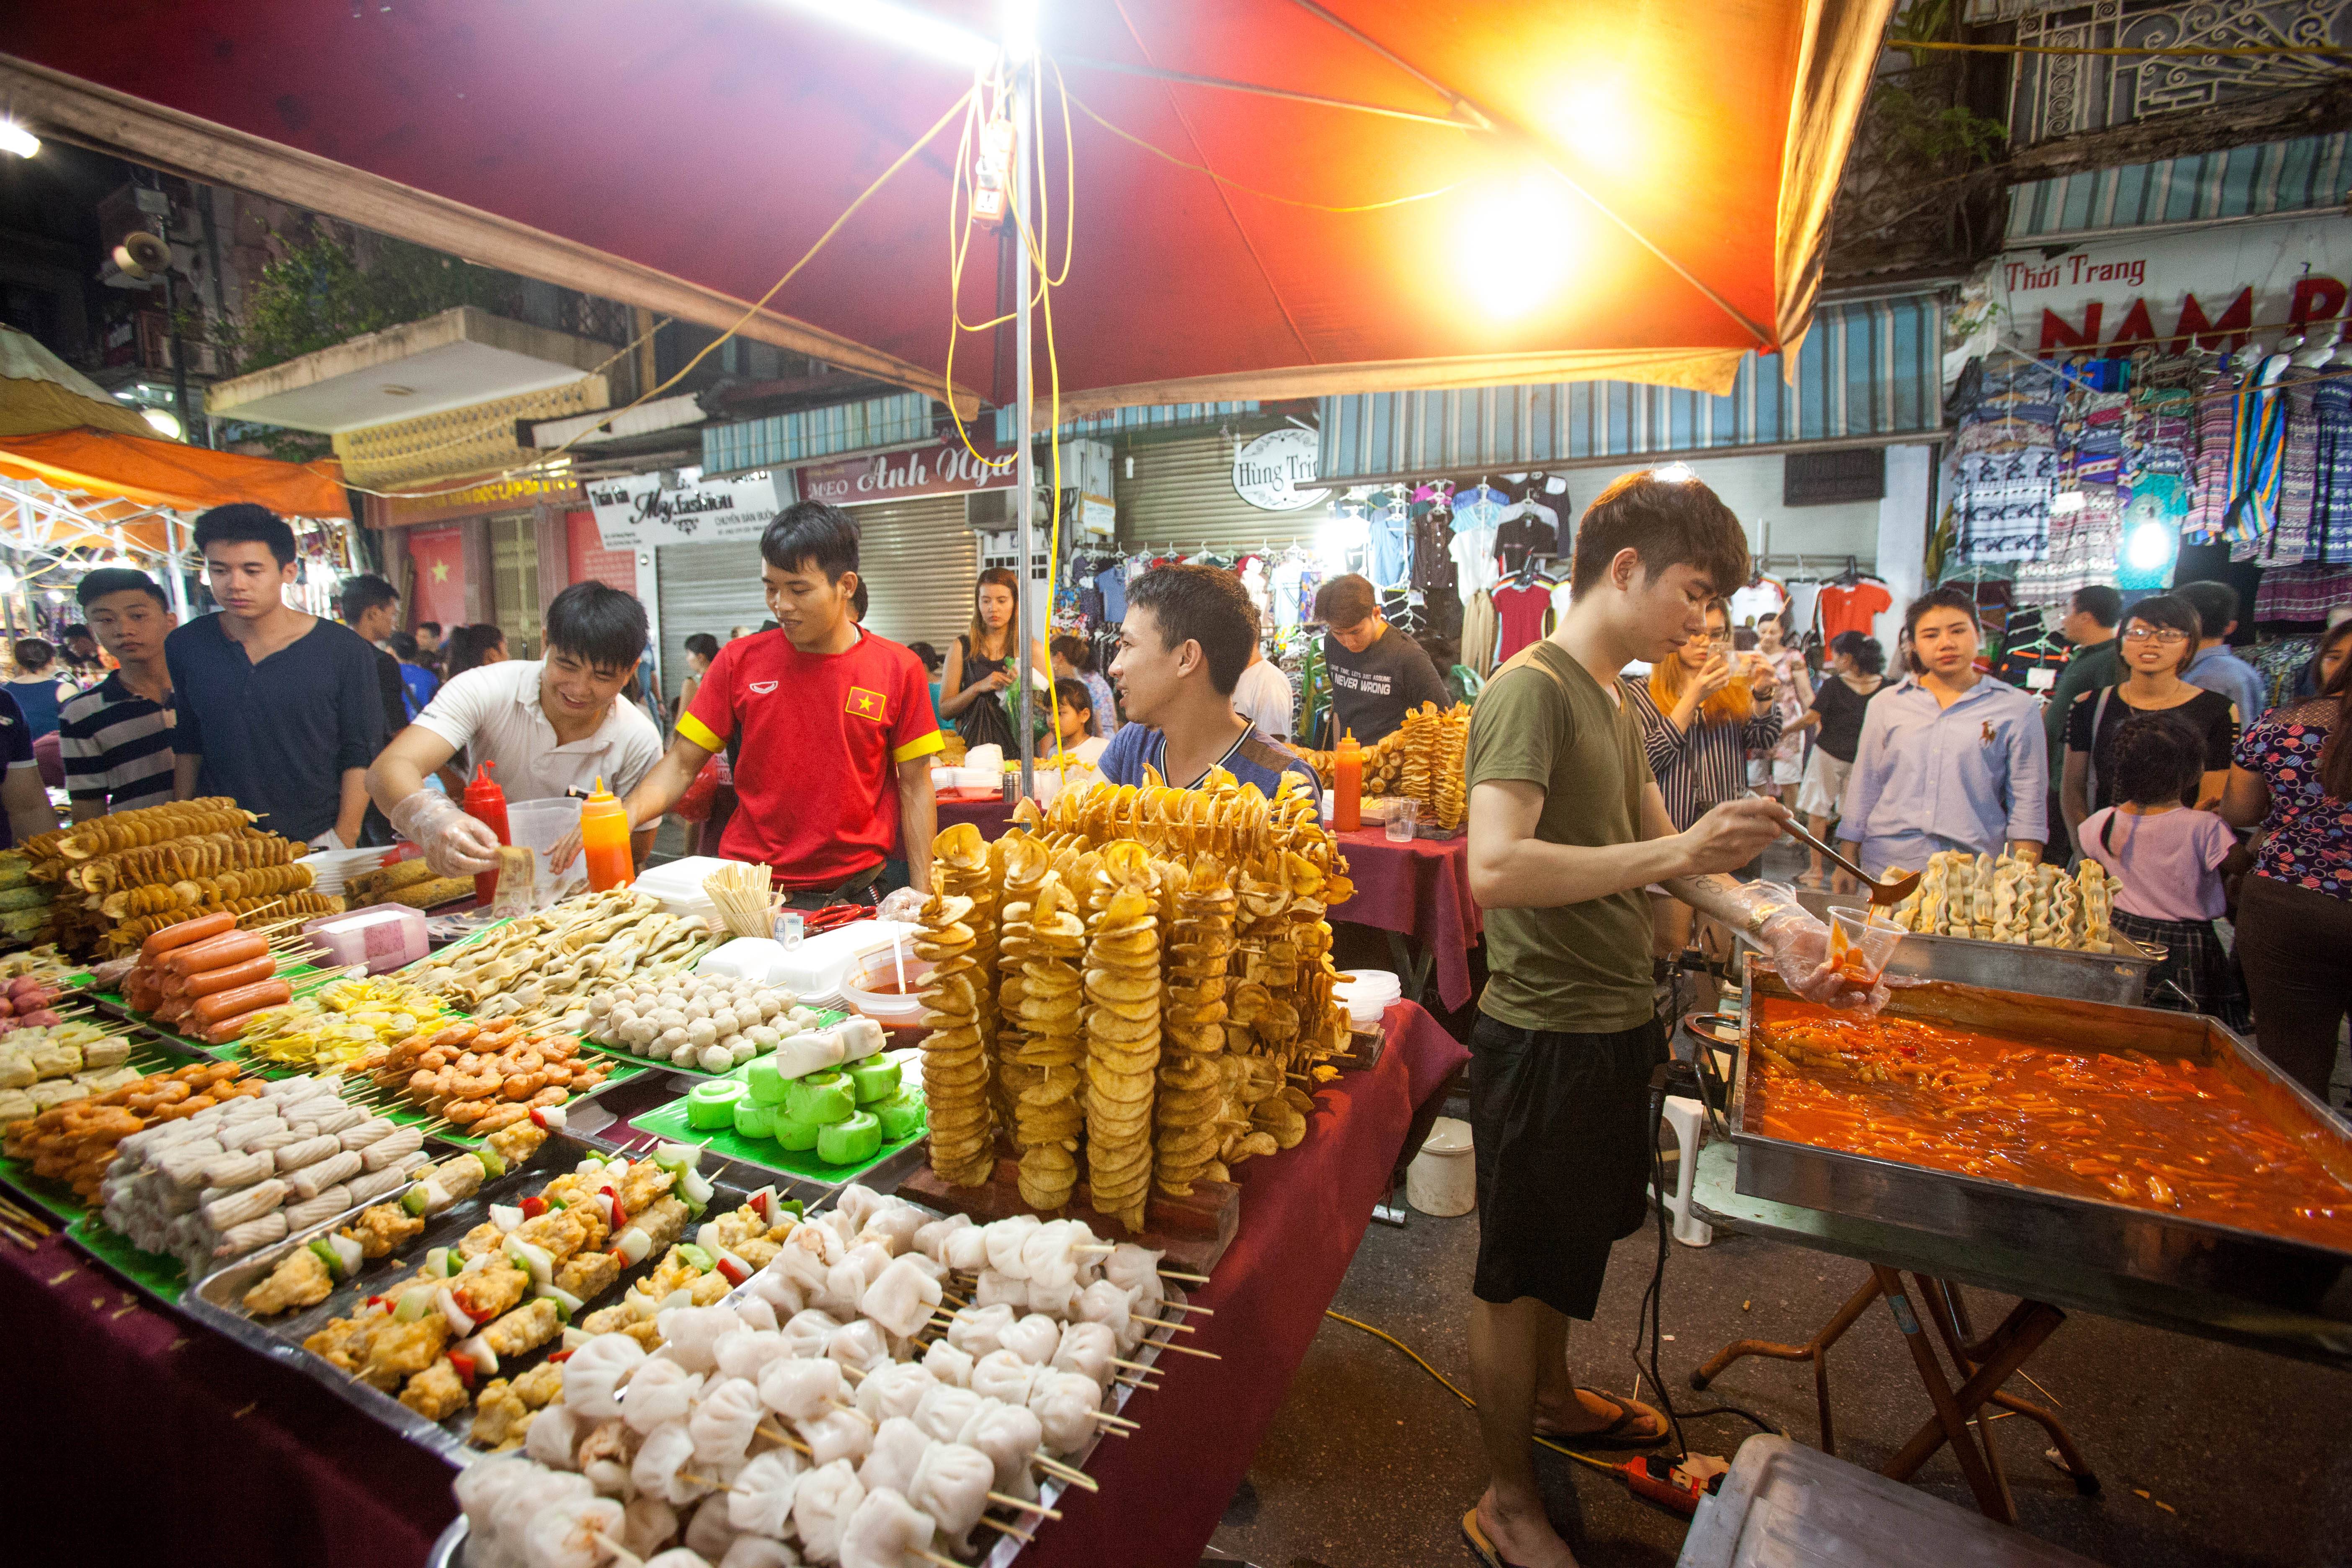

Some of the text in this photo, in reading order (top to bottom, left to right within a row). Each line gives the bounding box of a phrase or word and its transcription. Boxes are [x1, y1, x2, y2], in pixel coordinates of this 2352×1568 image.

[2004, 254, 2146, 291] Thời Trang
[857, 447, 1015, 493] Anh Nga
[1238, 462, 1284, 492] Hùng
[1335, 673, 1358, 690] NEVER
[1361, 680, 1391, 695] WRONG
